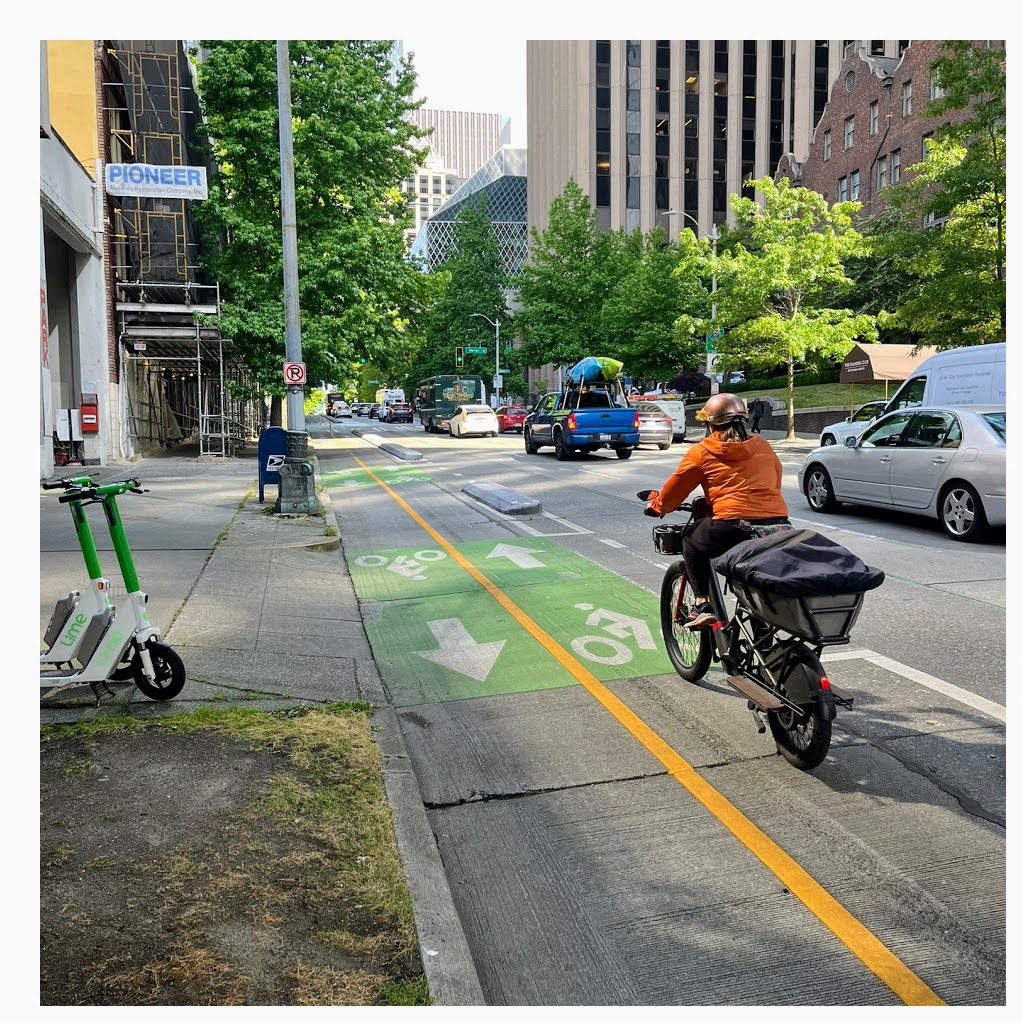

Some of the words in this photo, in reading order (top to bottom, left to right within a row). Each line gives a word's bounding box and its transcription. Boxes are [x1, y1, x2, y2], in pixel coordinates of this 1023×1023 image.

[109, 165, 202, 187] PIONEER
[110, 185, 134, 193] Masonry
[60, 612, 88, 648] Lime
